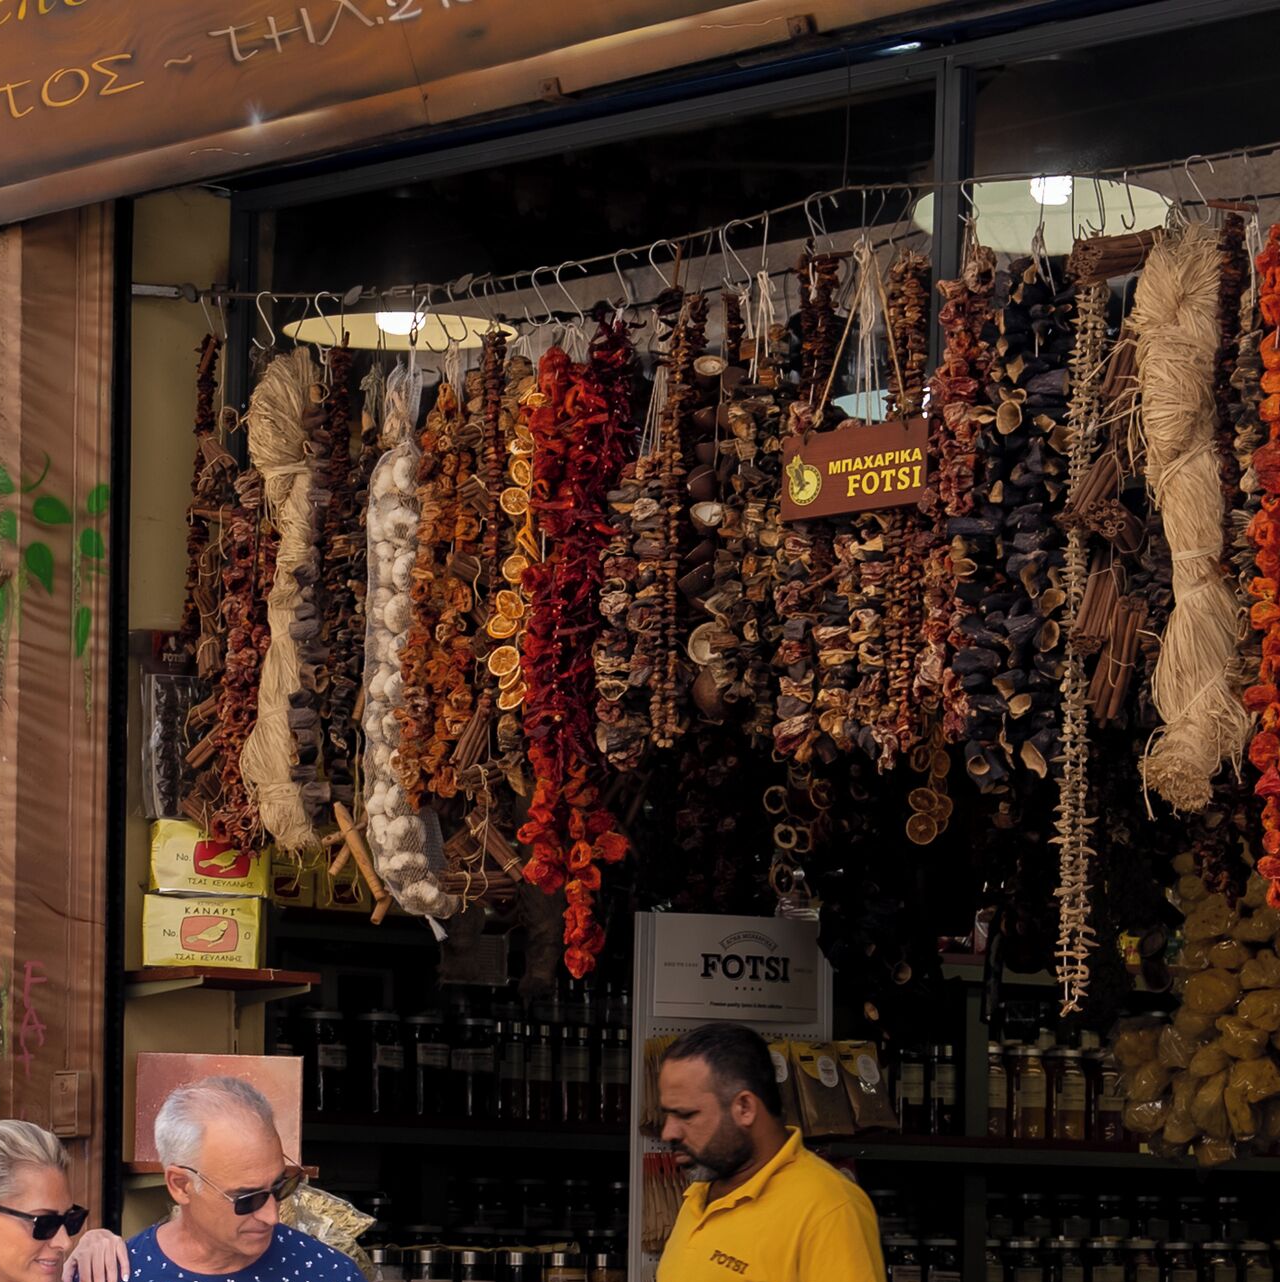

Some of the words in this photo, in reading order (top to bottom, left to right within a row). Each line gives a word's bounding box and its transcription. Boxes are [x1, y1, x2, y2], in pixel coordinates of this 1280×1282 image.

[828, 447, 923, 475] ΜΠΑΧΑΡΙΚΑ
[846, 465, 922, 498] FOTSI
[162, 652, 187, 663] FOTSI
[700, 952, 790, 983] FOTSI
[709, 1249, 749, 1275] FOTSI
